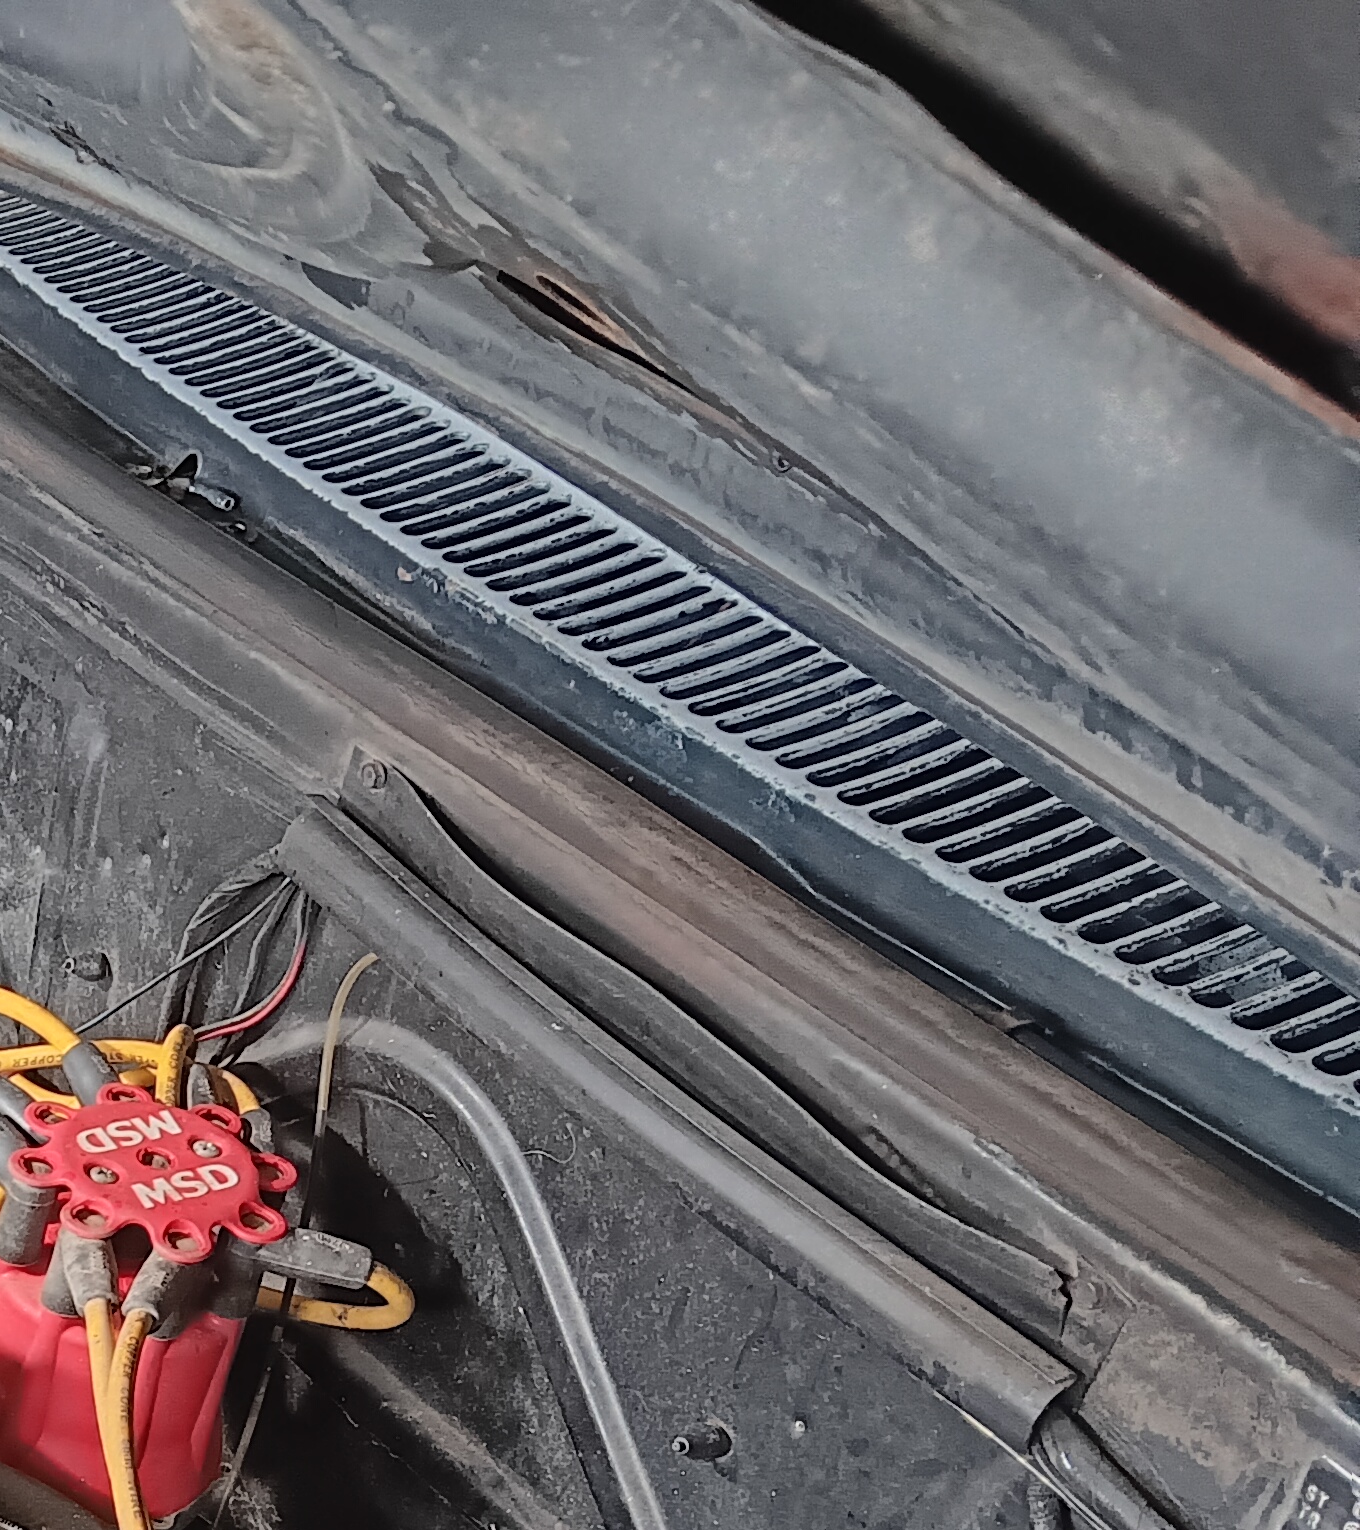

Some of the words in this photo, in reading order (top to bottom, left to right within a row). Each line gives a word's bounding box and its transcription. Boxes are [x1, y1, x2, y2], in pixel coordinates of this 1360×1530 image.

[11, 1053, 64, 1071] COPPER
[76, 1109, 184, 1154] MSD
[130, 1163, 240, 1211] MSD
